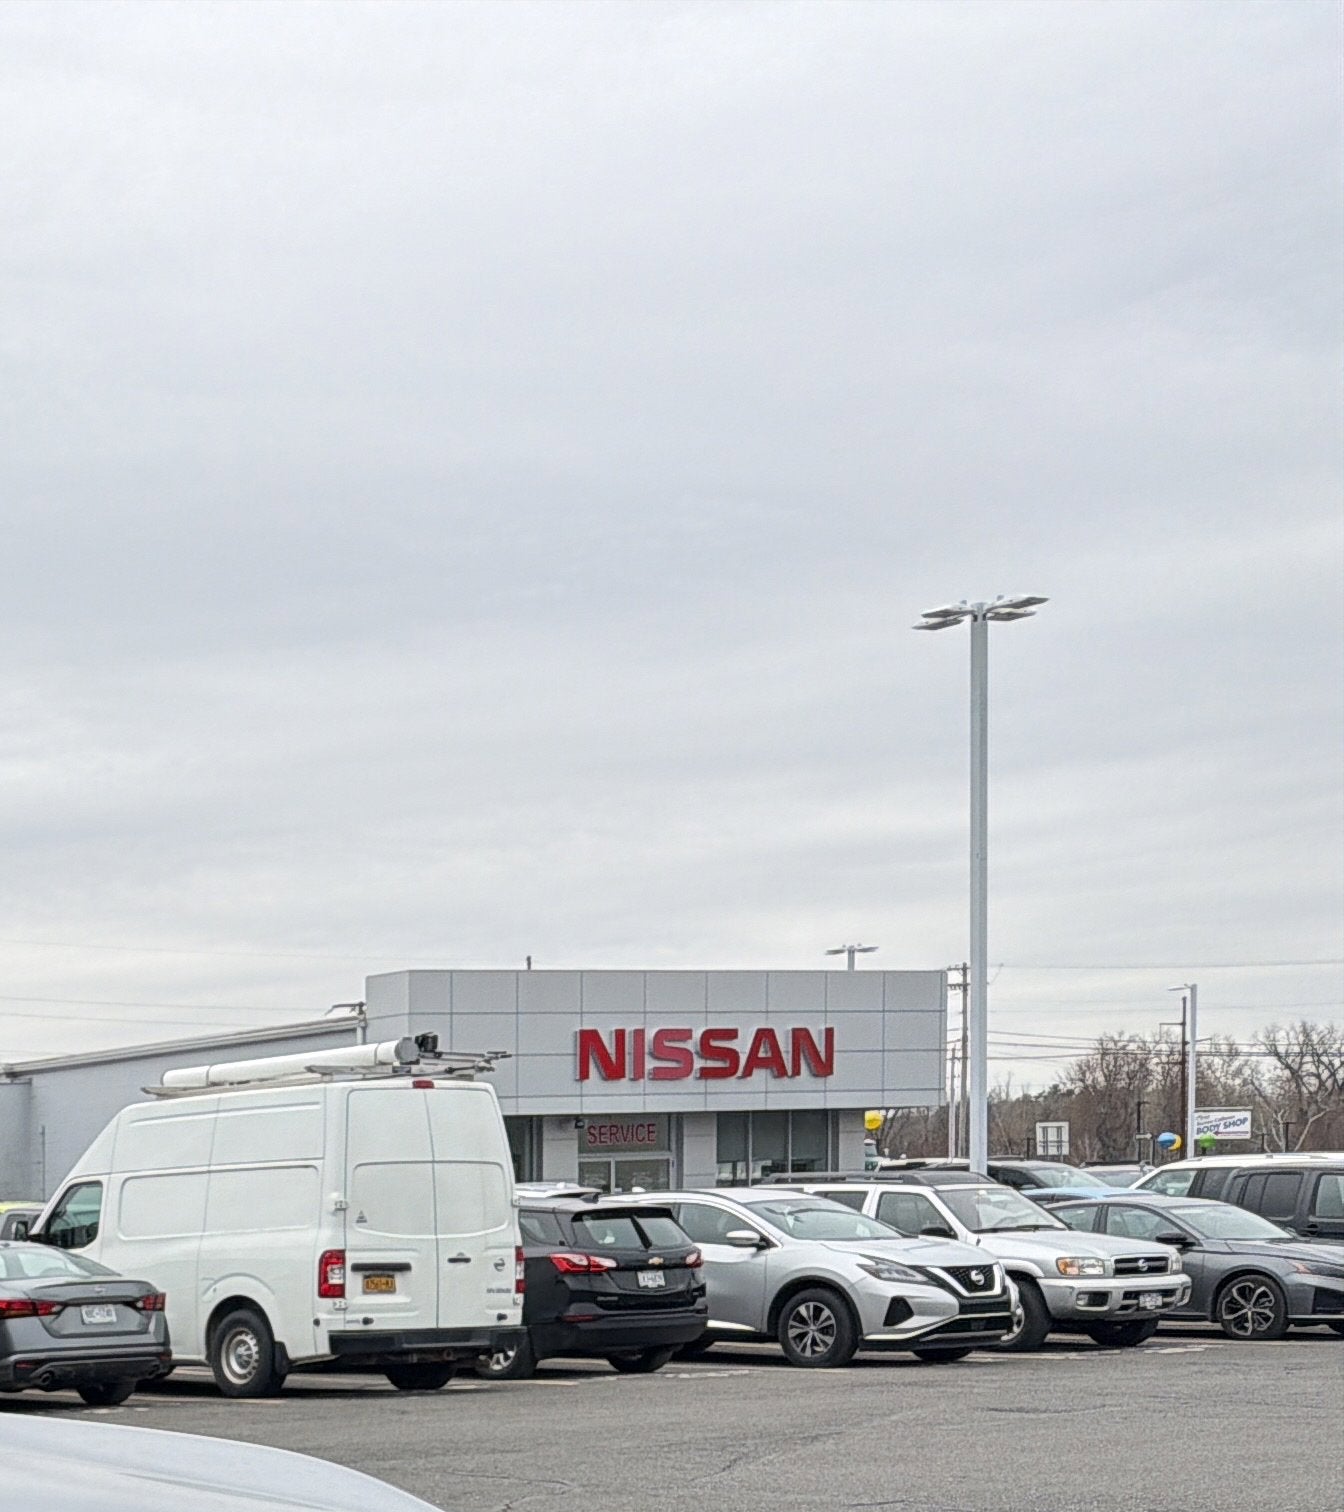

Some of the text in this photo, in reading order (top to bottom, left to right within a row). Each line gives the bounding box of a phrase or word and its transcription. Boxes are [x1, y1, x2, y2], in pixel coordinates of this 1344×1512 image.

[576, 1027, 834, 1081] NISSAN
[587, 1123, 656, 1145] SERVICE
[1197, 1123, 1221, 1135] BODY
[1223, 1117, 1249, 1129] SHOP
